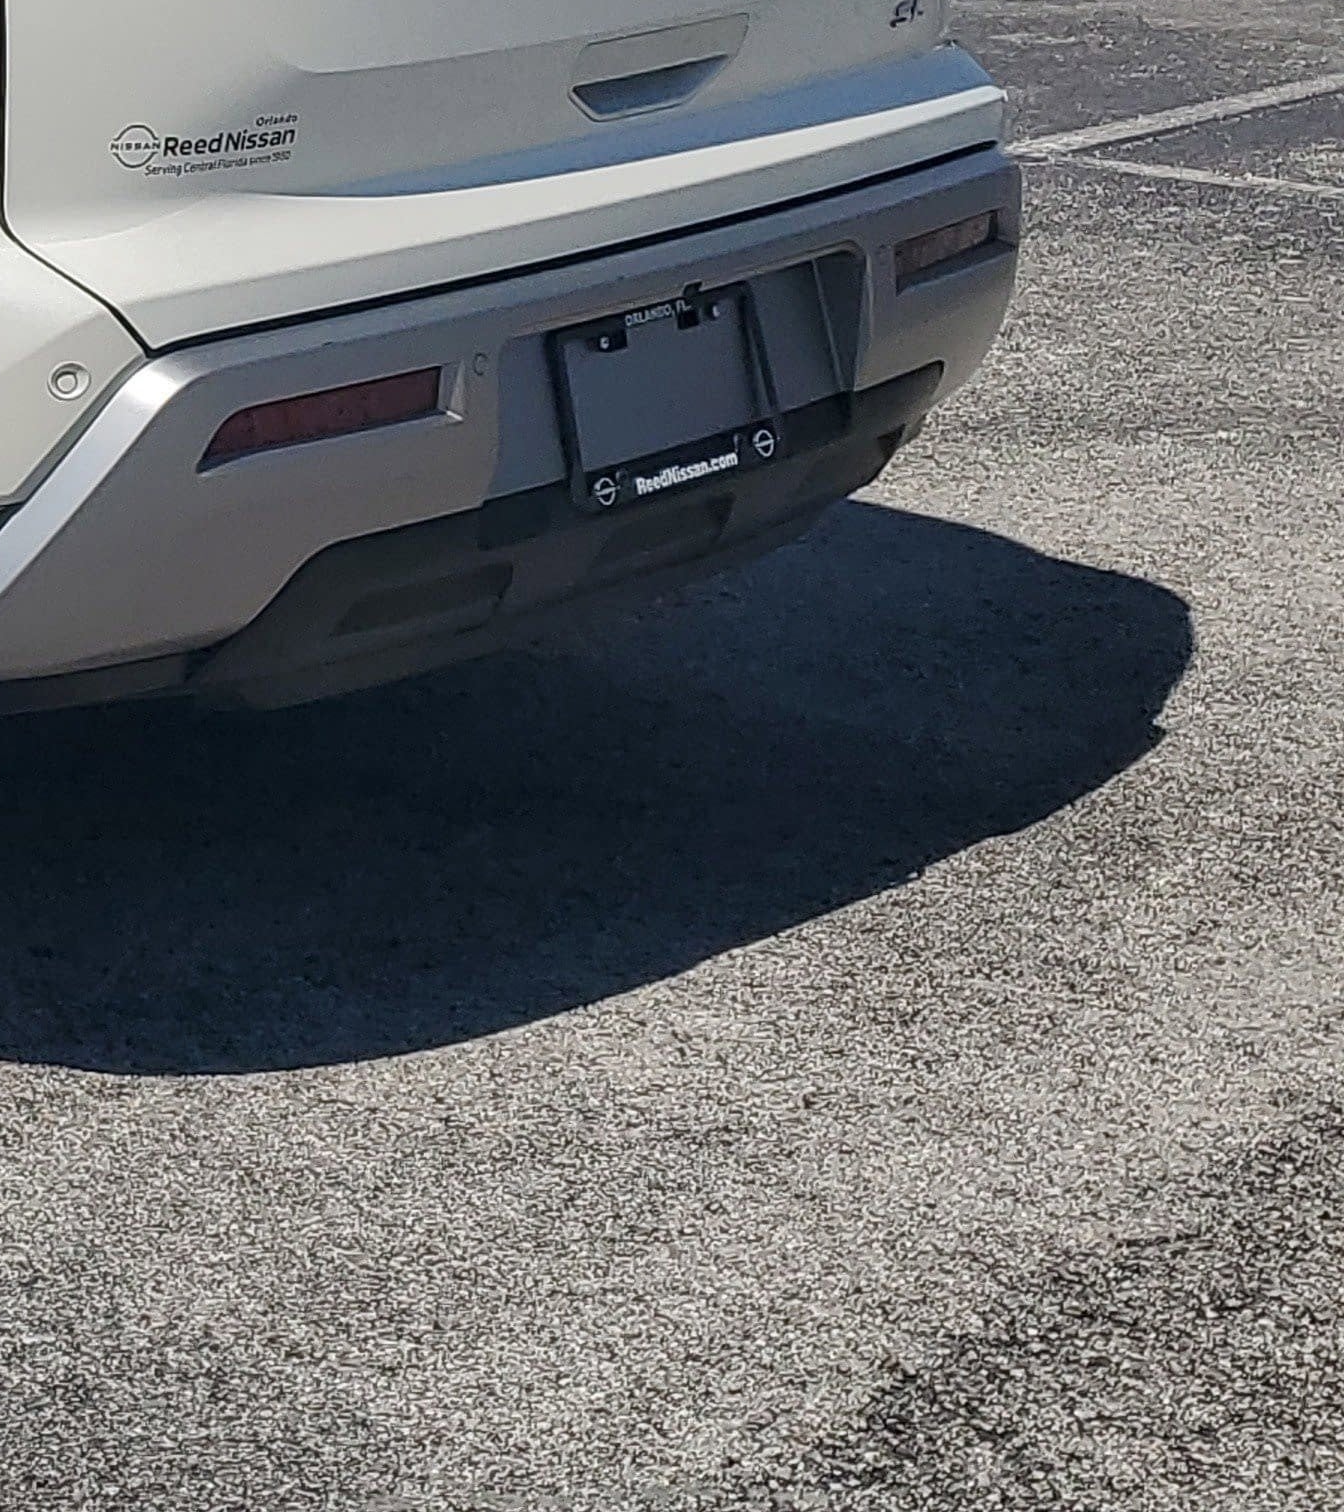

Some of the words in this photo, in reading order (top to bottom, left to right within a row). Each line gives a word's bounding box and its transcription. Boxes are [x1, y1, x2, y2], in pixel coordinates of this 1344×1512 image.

[255, 114, 298, 127] Orlando
[110, 141, 160, 151] NISSAN
[144, 163, 182, 178] Serving
[635, 451, 739, 496] ReedNissan.com
